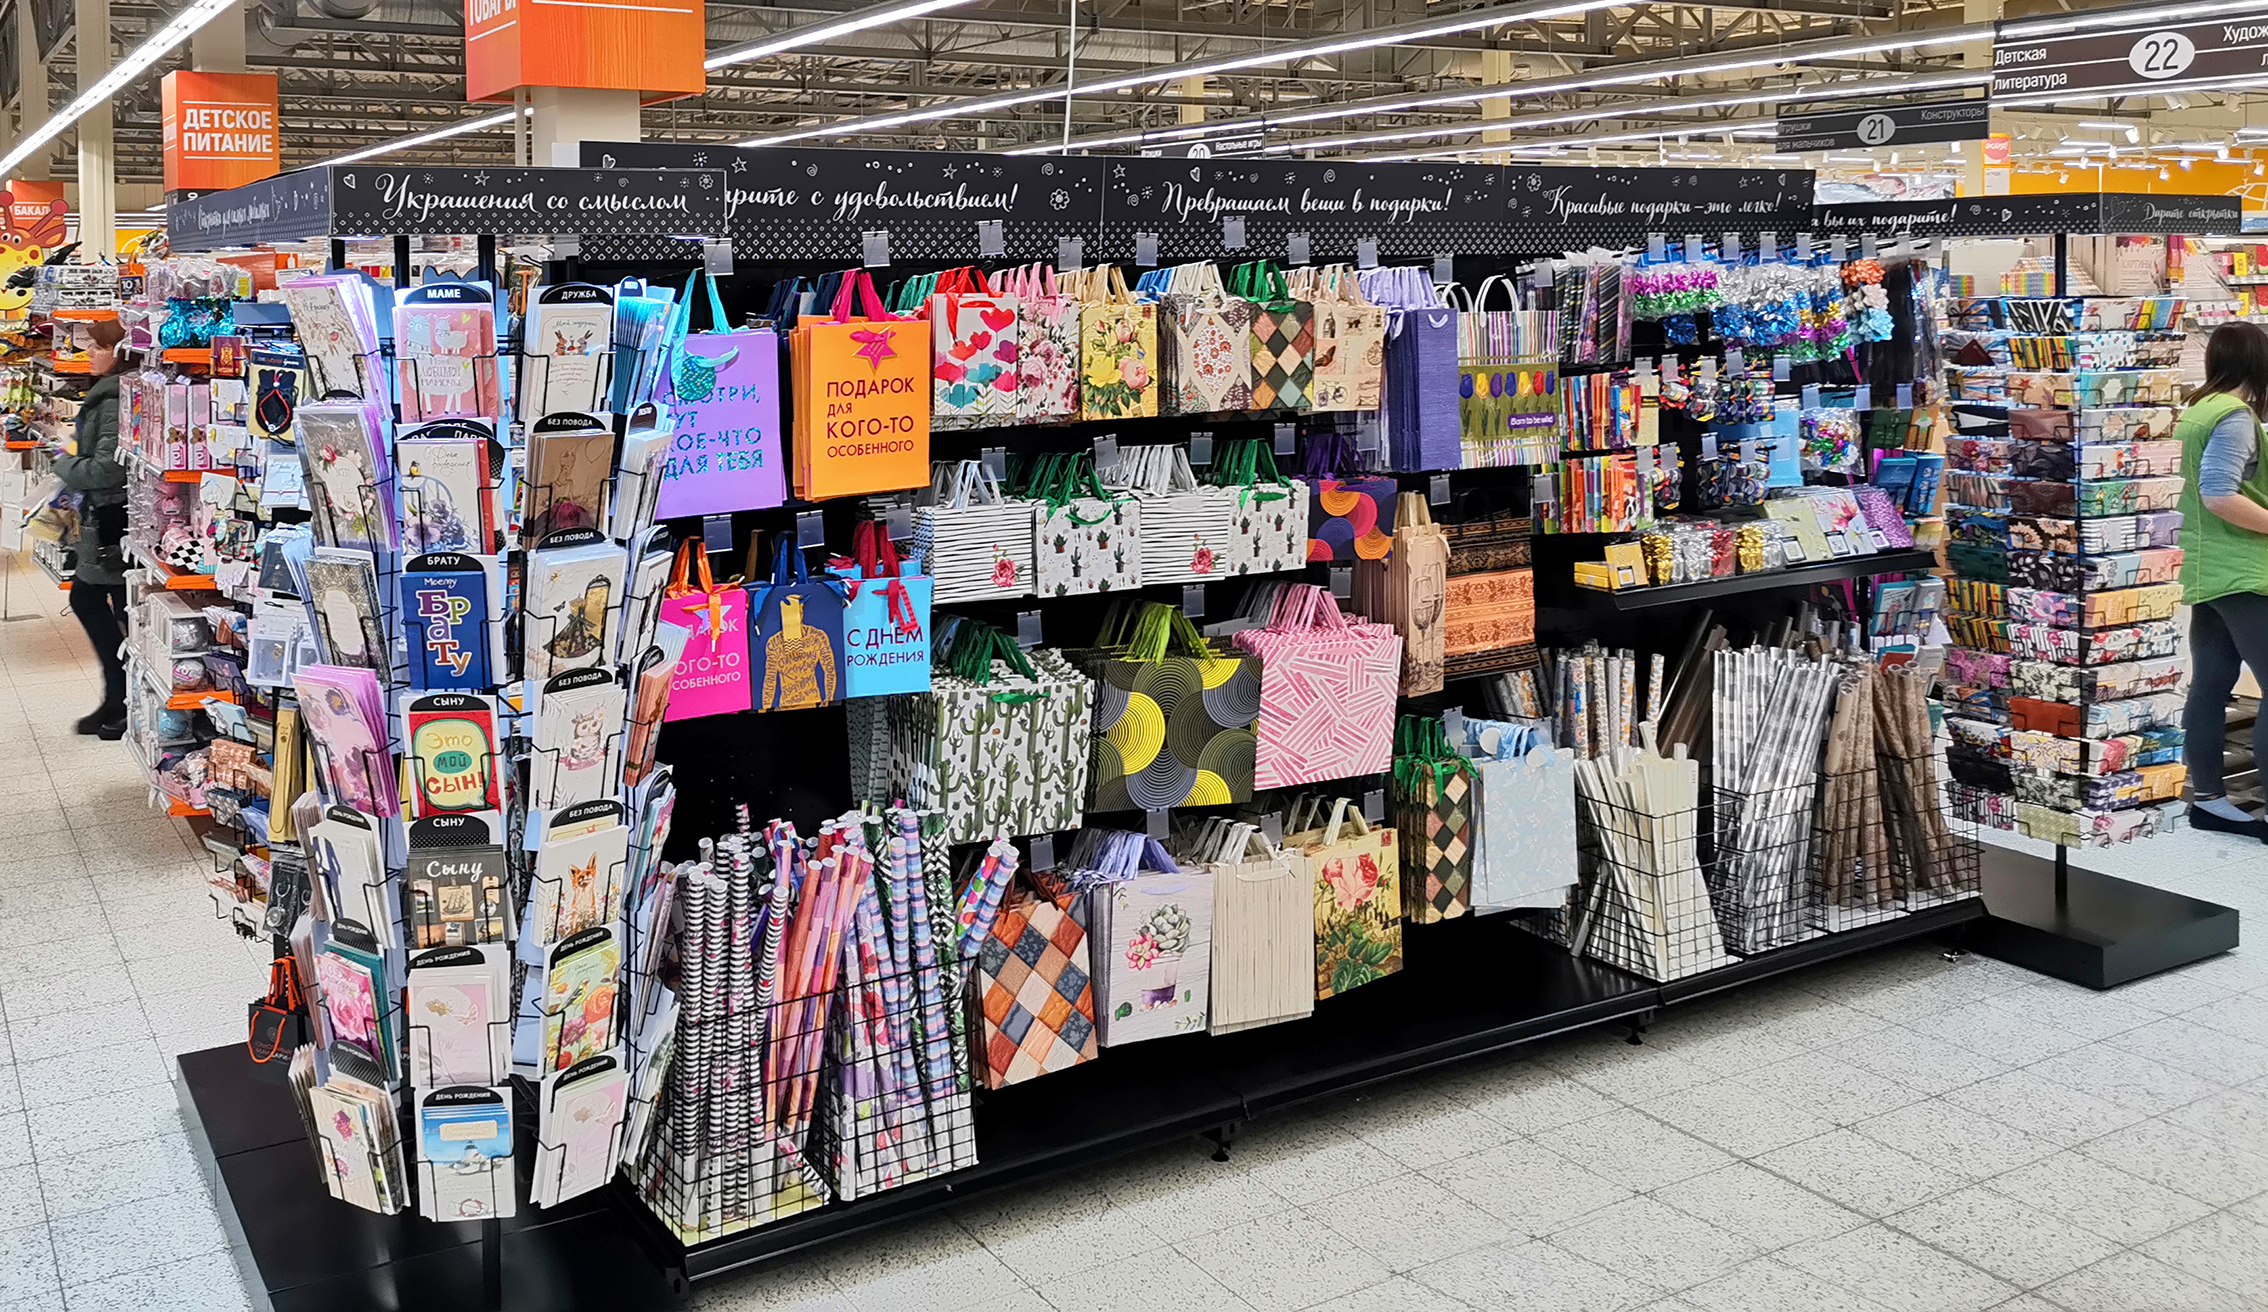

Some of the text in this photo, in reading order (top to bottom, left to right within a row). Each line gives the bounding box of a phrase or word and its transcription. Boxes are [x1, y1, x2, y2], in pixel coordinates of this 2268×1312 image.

[1994, 47, 2047, 66] Детская
[2144, 38, 2179, 72] 22
[1993, 73, 2067, 91] литература
[183, 108, 272, 130] ДЕТСКОЕ
[1921, 107, 1984, 121] Конструкторы
[1866, 118, 1884, 140] 21
[183, 132, 273, 153] ПИТАНИЕ
[1792, 138, 1835, 151] мальчиков
[375, 172, 690, 223] Украшения со смыслом
[811, 190, 824, 206] с
[832, 180, 1019, 222] удовольствием!
[1160, 180, 1453, 224] Превращаем вещи в подарки!
[1542, 184, 1626, 225] Красивые
[1738, 191, 1782, 215] легко!
[14, 205, 51, 216] БАКАЛ
[2141, 202, 2185, 227] Дарите
[1871, 203, 1958, 238] подарите!
[427, 288, 461, 299] МАМЕ
[561, 290, 597, 300] ДРУЖБА
[826, 376, 915, 398] ПОДАРОК
[827, 402, 853, 417] ДЛЯ
[548, 418, 593, 427] БЕЗ ПОВОДА
[826, 415, 915, 439] КОГО-ТО
[826, 440, 915, 459] ОСОБЕННОГО
[663, 449, 763, 481] ДЛЯ ТЕБЯ
[550, 531, 595, 545] БЕЗ ПОВОДА
[427, 556, 460, 566] БРАТУ
[424, 578, 458, 590] Моему
[847, 629, 862, 647] С
[674, 652, 740, 676] ОГО-ТО
[846, 649, 925, 668] РОЖДЕНИЯ
[558, 672, 603, 687] БЕЗ ПОВОДА
[671, 671, 741, 692] СОБЕННОГО
[433, 697, 465, 706] СЫНУ
[568, 802, 614, 818] БЕЗ ПОВОДА
[433, 818, 465, 828] СЫНУ
[426, 860, 483, 882] Сыну
[560, 931, 604, 953] ДЕНЬ РОЖДЕНИЯ
[416, 950, 471, 967] ДЕНЬ РОЖДЕНИЯ
[563, 1058, 608, 1081] ДЕНЬ РОЖДЕНИЯ
[435, 1091, 490, 1101] ДЕНЬ РОЖДЕНИЯ
